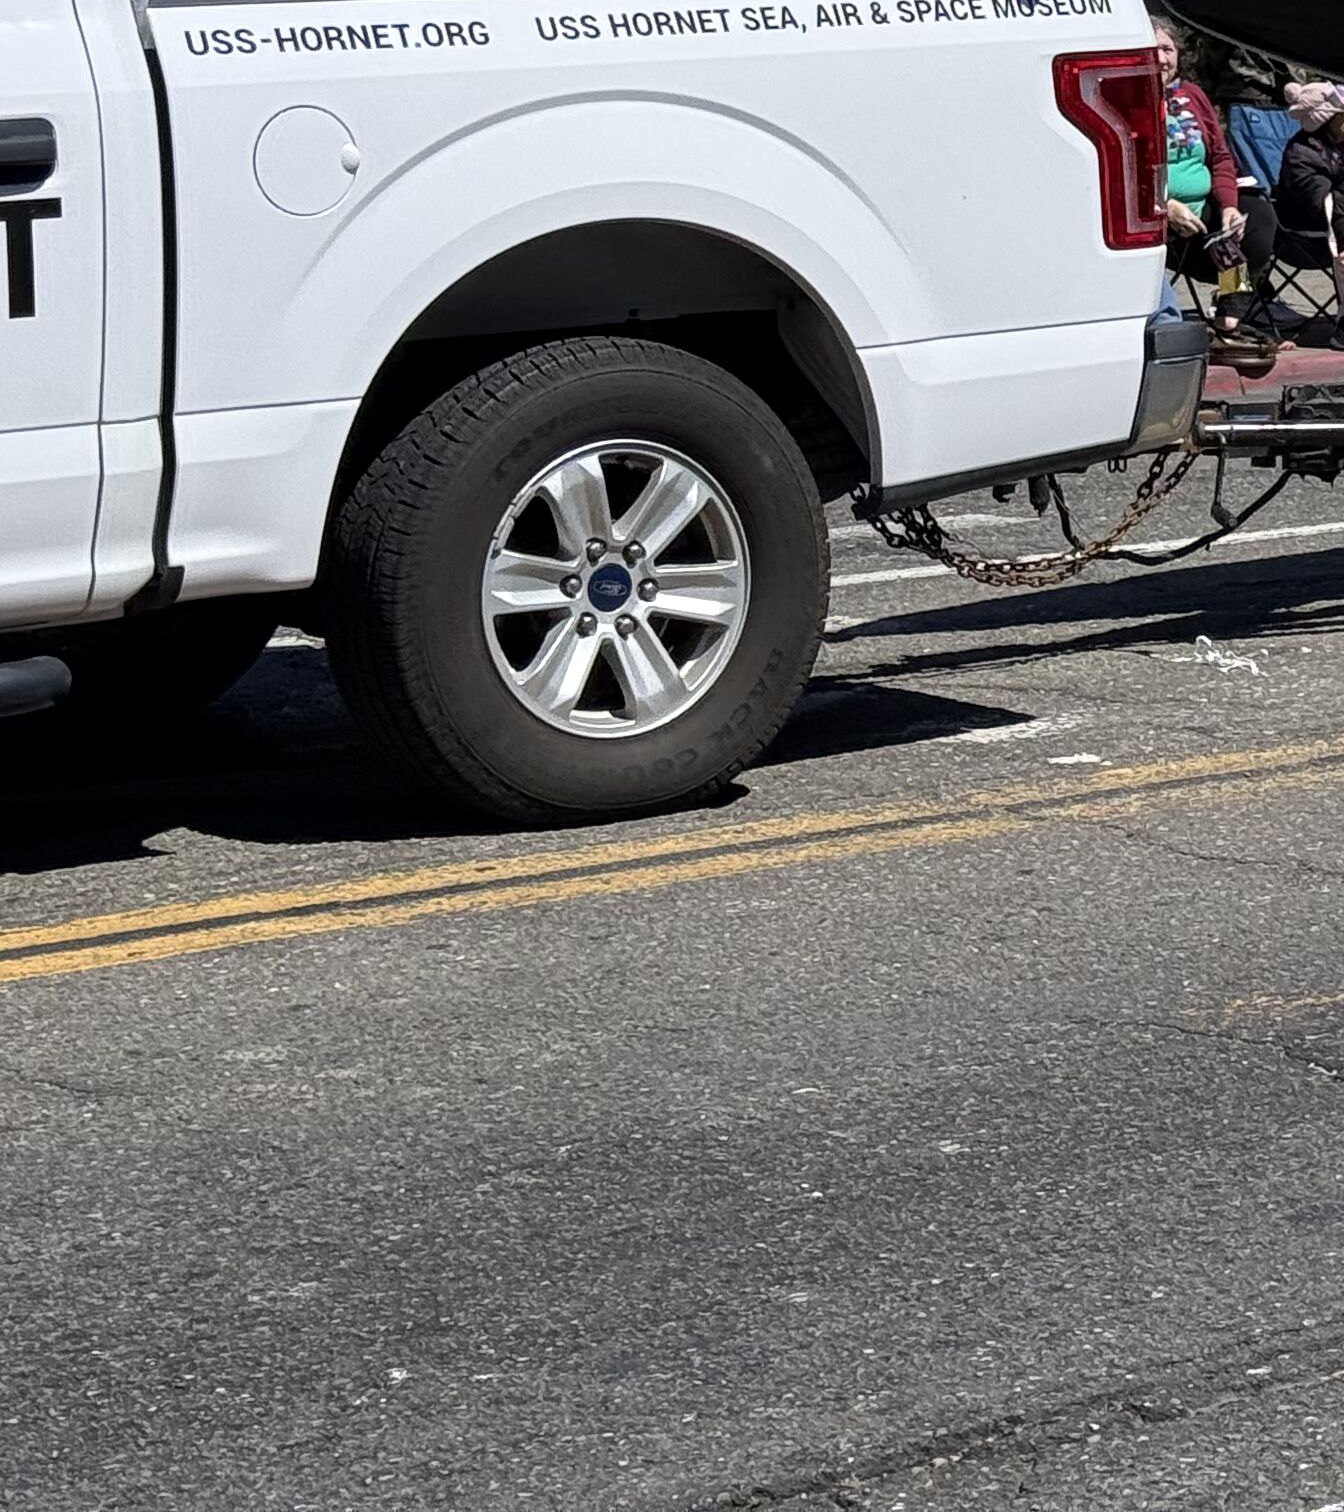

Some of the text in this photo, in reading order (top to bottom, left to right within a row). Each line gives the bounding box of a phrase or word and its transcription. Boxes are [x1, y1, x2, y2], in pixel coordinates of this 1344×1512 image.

[185, 21, 490, 56] USS-HORNET.ORG
[535, 14, 601, 41] USS
[610, 8, 731, 39] HORNET
[742, 5, 807, 34] SEA,
[816, 2, 858, 28] AIR
[871, 0, 890, 25] &
